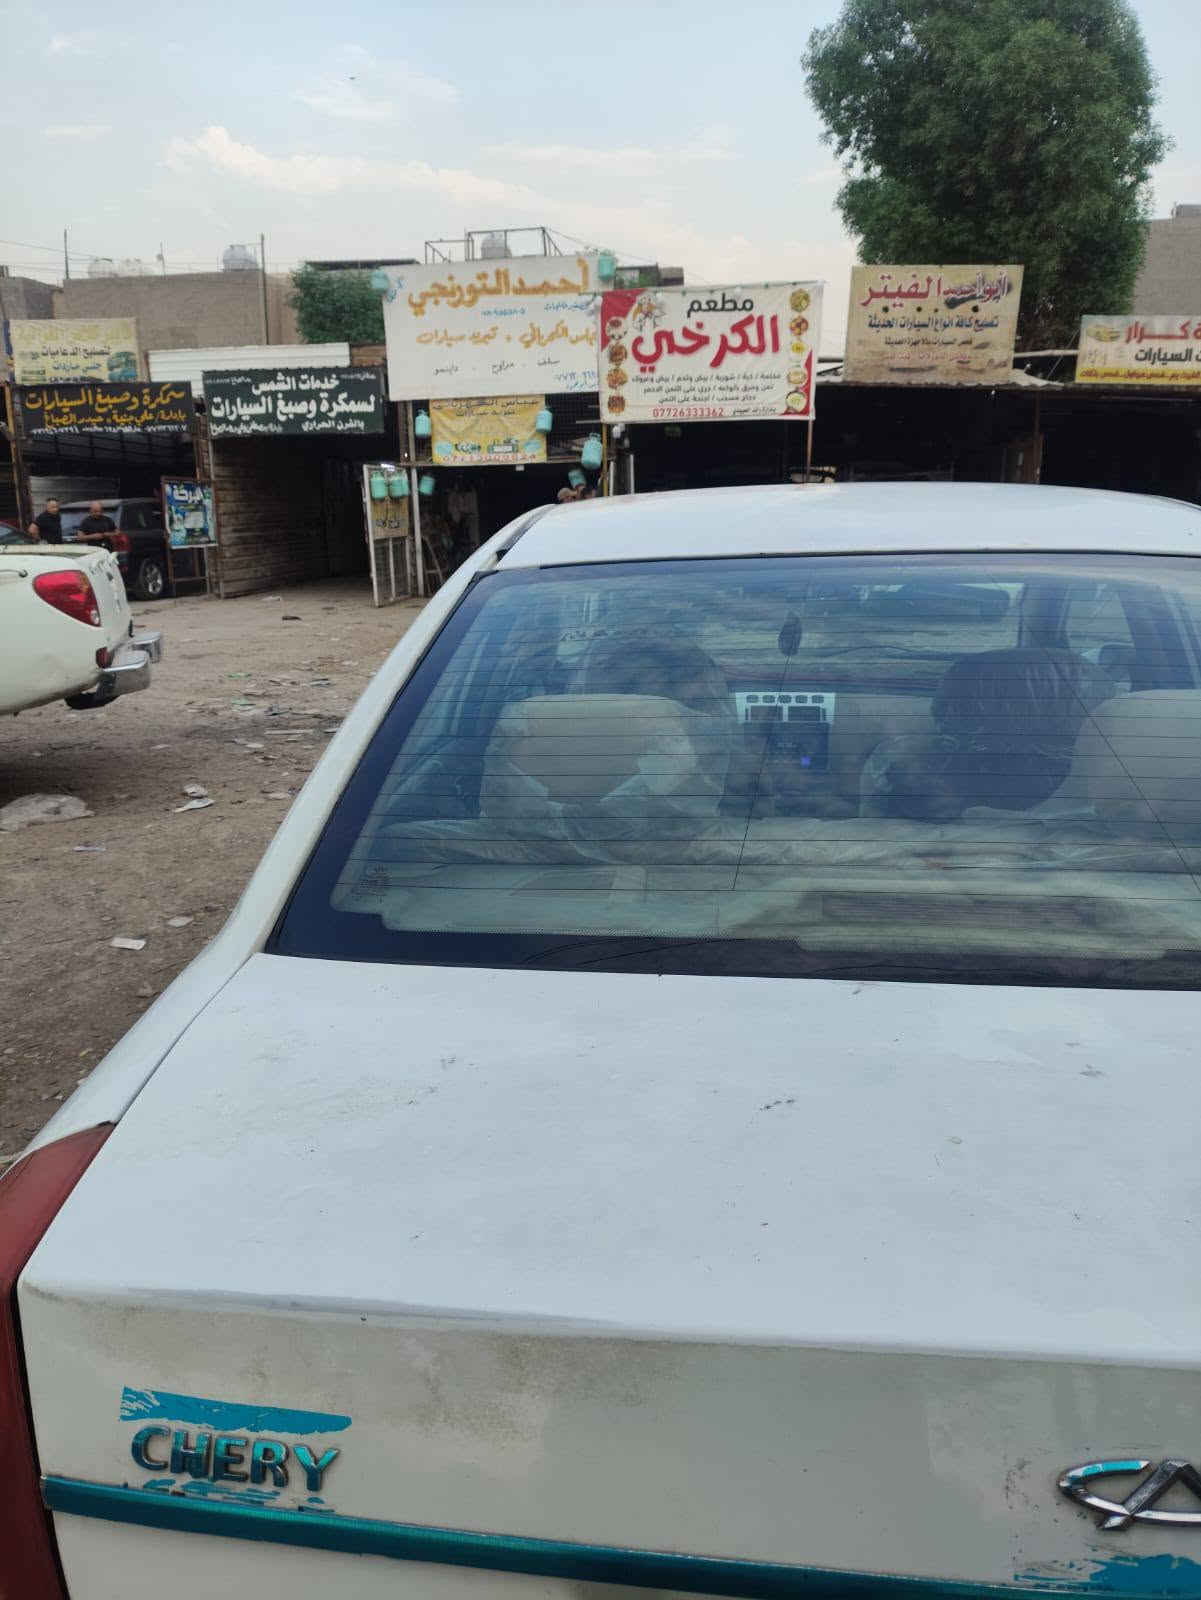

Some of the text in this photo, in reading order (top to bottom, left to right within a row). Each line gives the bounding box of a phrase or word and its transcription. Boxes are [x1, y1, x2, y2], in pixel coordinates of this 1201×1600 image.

[861, 273, 941, 307] الفيتر
[687, 293, 754, 318] مطعم
[416, 328, 465, 347] سيارات
[632, 314, 780, 373] الكرخي
[1126, 320, 1192, 344] كرار
[1135, 347, 1193, 366] السيارات
[252, 372, 297, 395] الشمس
[299, 373, 340, 390] خدمات
[25, 383, 185, 413] سمكرة وصبغ السيارات
[211, 391, 375, 421] لسمكرة وصبغ السيارات
[652, 407, 724, 419] 07726333362
[131, 1424, 340, 1492] CHERY
